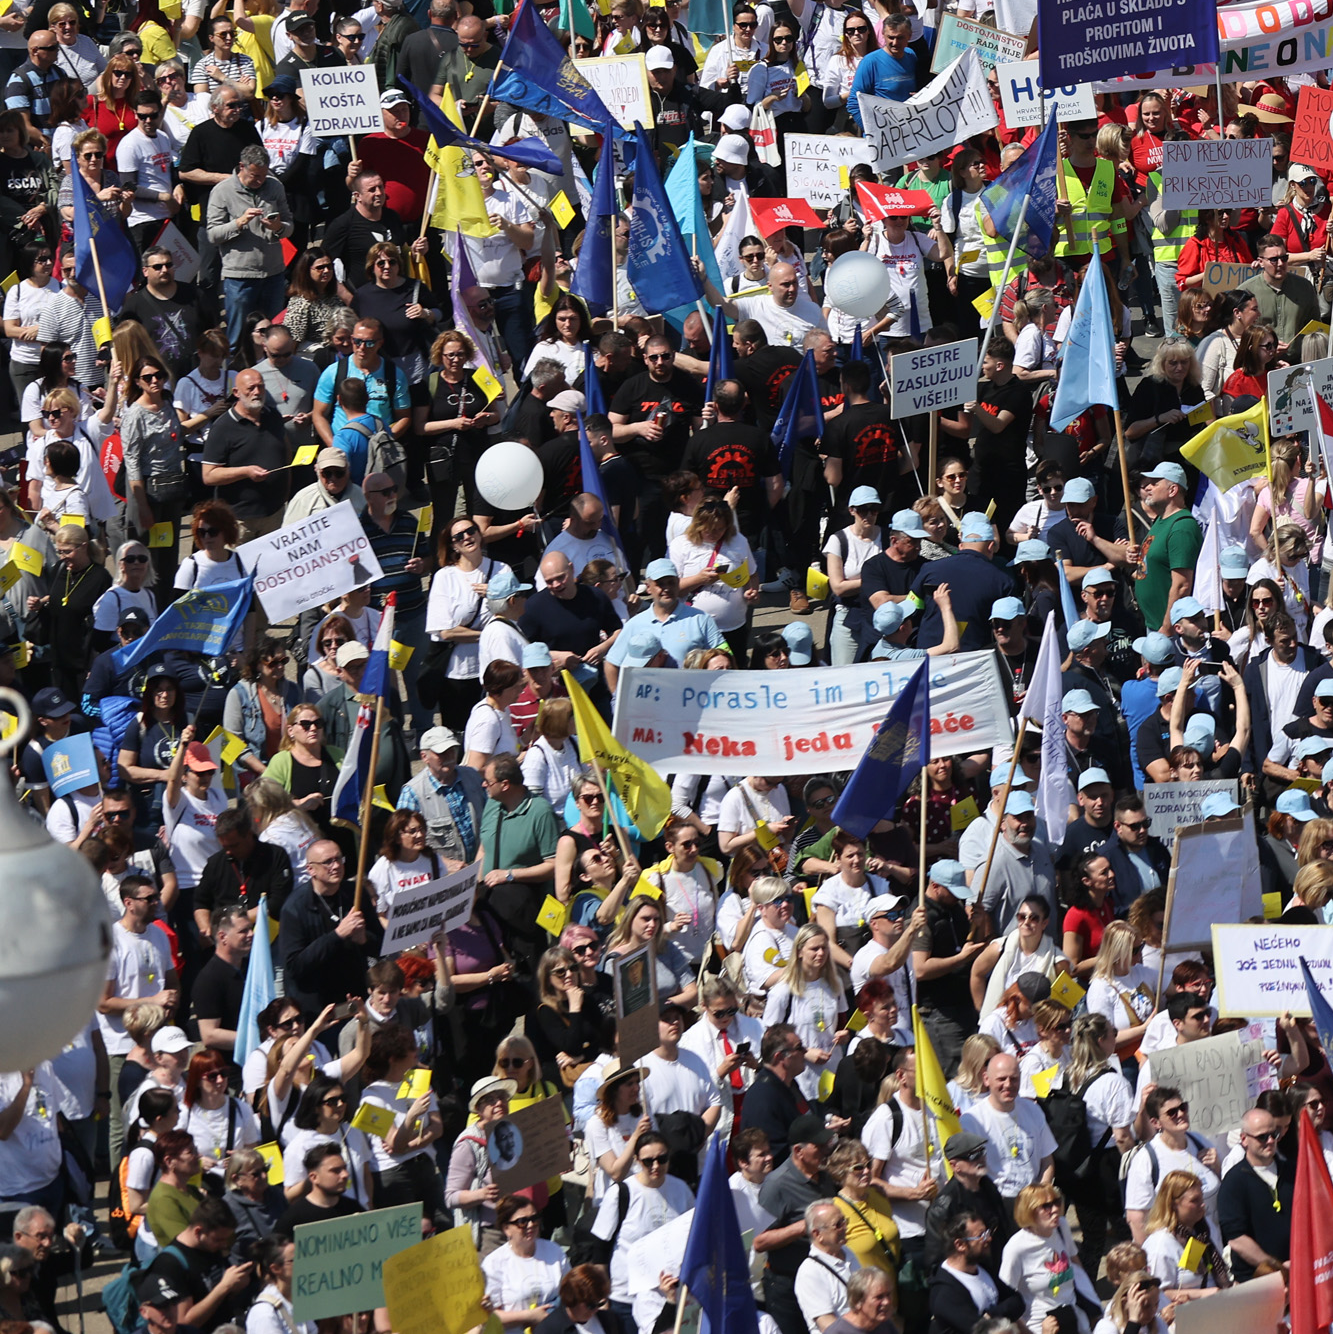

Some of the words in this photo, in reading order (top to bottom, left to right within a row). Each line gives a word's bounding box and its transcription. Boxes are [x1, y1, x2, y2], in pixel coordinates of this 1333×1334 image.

[1062, 0, 1104, 25] PLAĆA
[1107, 2, 1116, 18] U
[956, 20, 1024, 49] DOSTOJANSTVO
[1085, 20, 1154, 43] PROFITOM
[976, 38, 999, 52] RADA
[1002, 46, 1022, 59] NIJE
[1058, 40, 1144, 70] TROŠKOVIMA
[1148, 32, 1196, 54] ŽIVOTA
[311, 70, 366, 87] KOLIKO
[319, 91, 366, 109] KOŠTA
[312, 112, 382, 134] ZDRAVLJE
[1166, 144, 1192, 162] RAD
[1197, 142, 1232, 162] PREKO
[1236, 140, 1272, 160] OBRTA
[1164, 173, 1251, 193] PRIKRIVENO
[1188, 186, 1270, 206] ZAPOSLENJE
[911, 347, 960, 372] SESTRE
[896, 361, 974, 395] ZASLUŽUJU
[912, 386, 959, 410] VIŠE!!!
[270, 516, 332, 551] VRATITE
[287, 539, 322, 563] NAM
[254, 536, 368, 594] DOSTOJANSTVO
[636, 683, 662, 702] AP:
[682, 684, 788, 711] Porasle
[809, 680, 843, 705] im
[632, 726, 664, 745] MA:
[682, 732, 758, 758] Neka
[1148, 790, 1176, 800] DAJTE
[1254, 934, 1301, 952] NEĆEMO
[1220, 1080, 1239, 1099] ZA
[297, 1224, 379, 1260] NOMINALNO
[297, 1263, 364, 1298] REALNO
